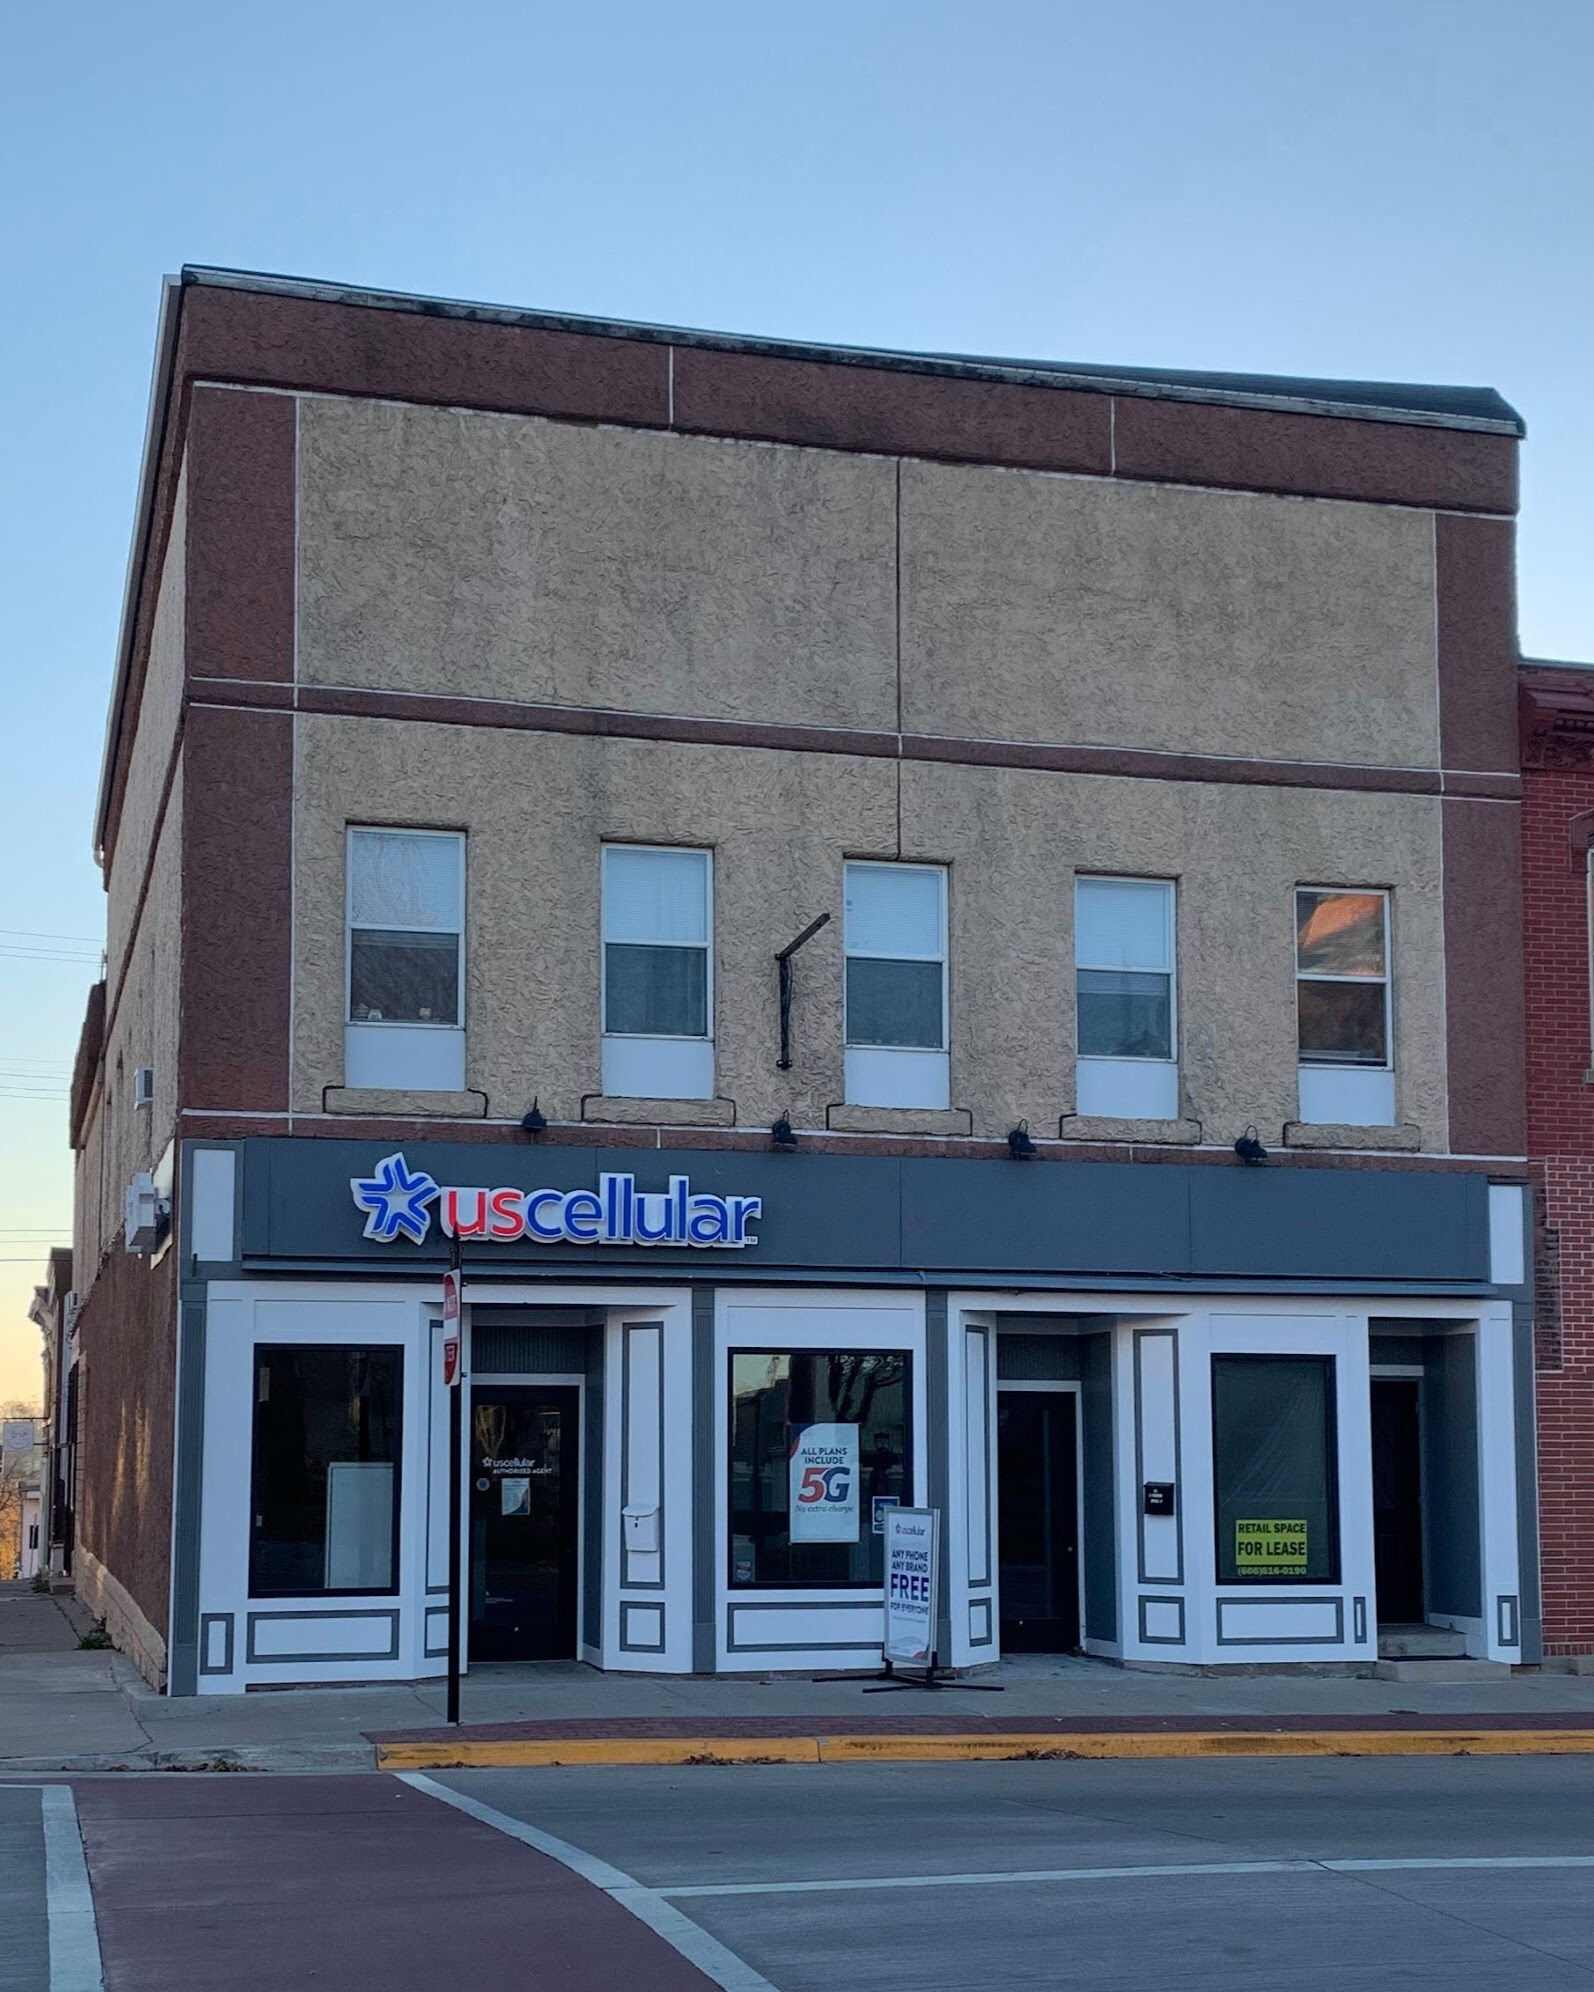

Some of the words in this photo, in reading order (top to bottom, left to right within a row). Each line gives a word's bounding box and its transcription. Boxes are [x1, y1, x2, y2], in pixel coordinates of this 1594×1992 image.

[446, 1175, 760, 1243] uscellular
[801, 1447, 817, 1456] ALL
[818, 1447, 848, 1456] PLANS
[804, 1456, 845, 1465] INCLUDE
[798, 1466, 851, 1503] 5G
[807, 1505, 827, 1513] extra
[828, 1505, 853, 1515] charge
[1238, 1523, 1272, 1534] RETAIL
[1273, 1523, 1306, 1534] SPACE
[1238, 1541, 1263, 1556] FOR
[1266, 1541, 1306, 1556] LEASE
[892, 1549, 905, 1560] ANY
[906, 1551, 928, 1562] PHONE
[891, 1560, 905, 1571] ANY
[906, 1561, 928, 1573] BRAND
[890, 1573, 930, 1602] FREE
[890, 1601, 902, 1611] FOR
[902, 1604, 929, 1616] EVERYONE
